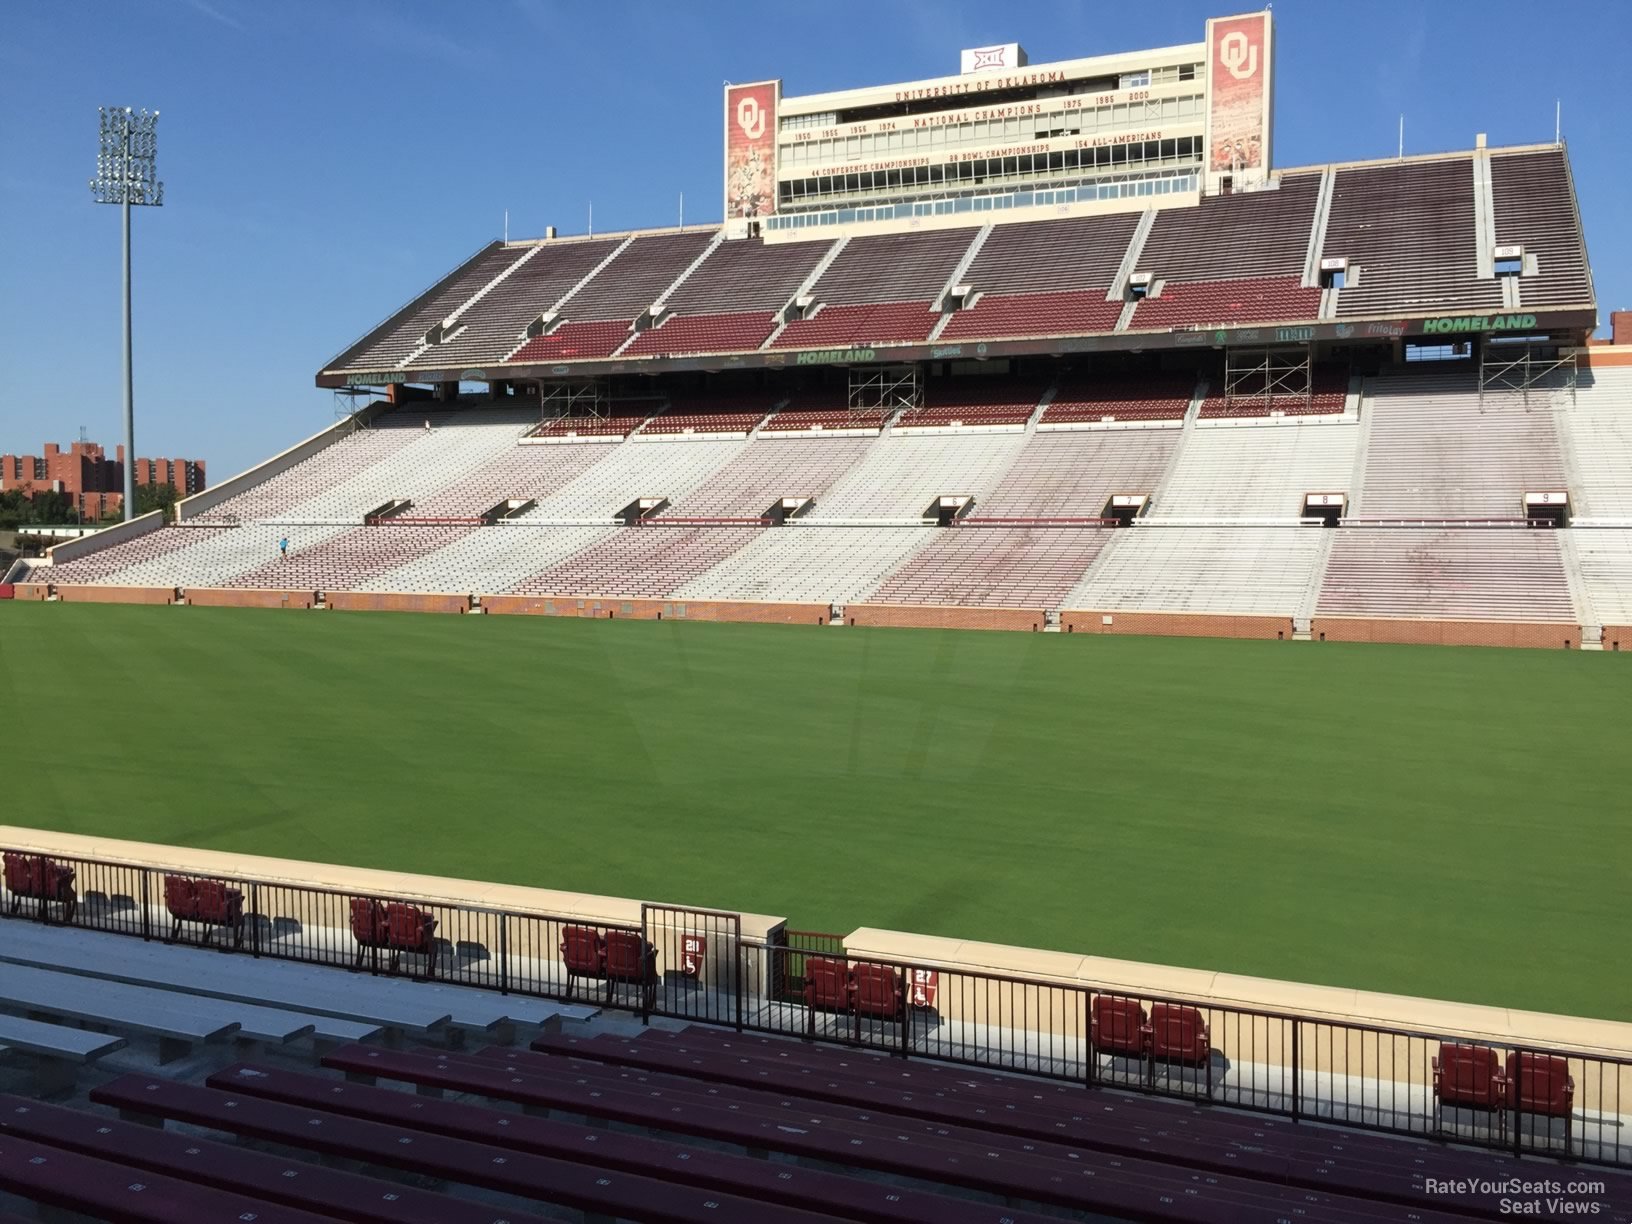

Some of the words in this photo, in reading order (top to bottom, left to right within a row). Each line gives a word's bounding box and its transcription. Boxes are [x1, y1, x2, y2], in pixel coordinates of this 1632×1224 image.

[1220, 31, 1257, 79] OU
[896, 83, 969, 102] UNIVERSITY
[976, 80, 990, 90] OF
[998, 71, 1065, 88] OKLAHOMA
[914, 112, 969, 128] NATIONAL
[975, 104, 1042, 120] CHAMPIONS
[1063, 100, 1082, 109] 1975
[1096, 96, 1115, 105] 1985
[1129, 91, 1149, 100] 2000
[737, 97, 766, 139] OU
[822, 164, 868, 176] CONFERENCE
[870, 157, 930, 171] CHAMPIONSHIPS
[962, 151, 983, 161] BOWL
[986, 144, 1050, 158] CHAMPIONSHIPS
[1075, 139, 1088, 149] 154
[1092, 131, 1162, 146] ALL-AMERICANS
[1423, 315, 1537, 333] HOMELAND
[797, 349, 876, 364] HOMELAND
[347, 372, 406, 385] HOMELAND
[1127, 496, 1132, 505] 7
[1322, 495, 1328, 504] 8
[1543, 493, 1549, 502] 9
[915, 969, 932, 983] 27
